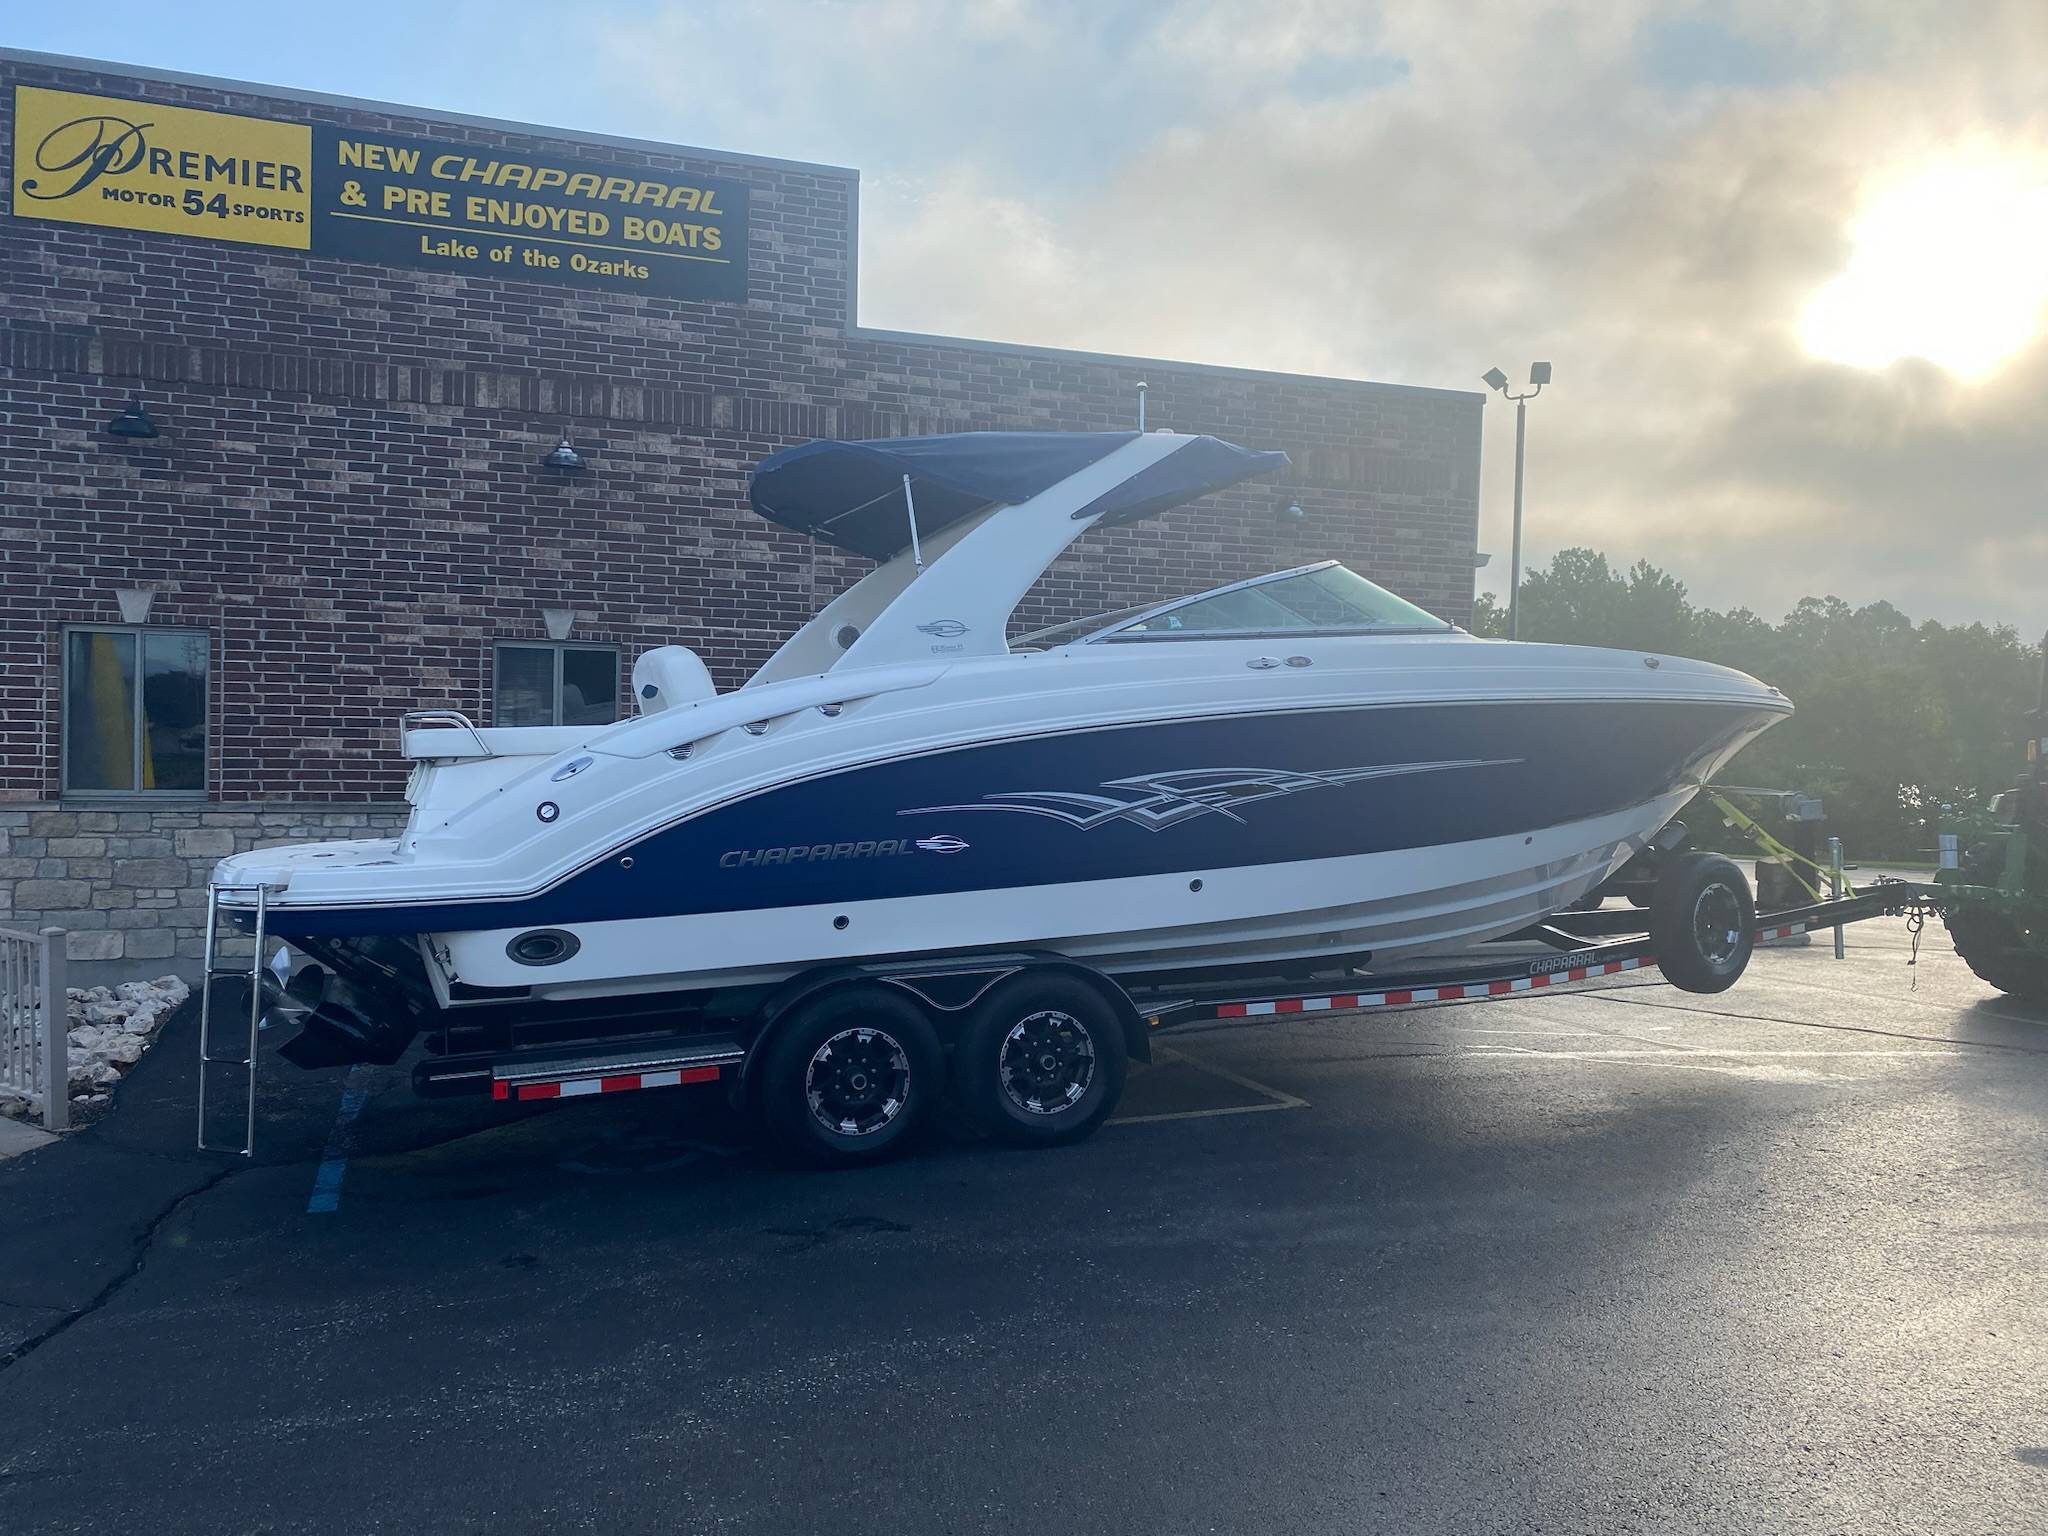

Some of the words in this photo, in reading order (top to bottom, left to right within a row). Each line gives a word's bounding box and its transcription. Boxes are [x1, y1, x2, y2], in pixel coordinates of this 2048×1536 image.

[22, 115, 304, 200] PREMIER
[338, 140, 421, 175] NEW
[431, 155, 724, 216] CHAPARRAL
[102, 187, 176, 208] MOTOR
[182, 189, 230, 219] 54
[233, 204, 305, 224] SPORTS
[340, 180, 367, 208] &
[383, 185, 451, 219] PRE
[466, 195, 610, 237] ENJOYED
[623, 216, 722, 251] BOATS
[421, 235, 479, 261] Lake
[489, 245, 512, 264] of
[522, 248, 560, 270] the
[570, 253, 650, 280] Ozarks
[719, 839, 914, 869] CHAPARRAL
[1529, 951, 1598, 975] CHAPARRAL
